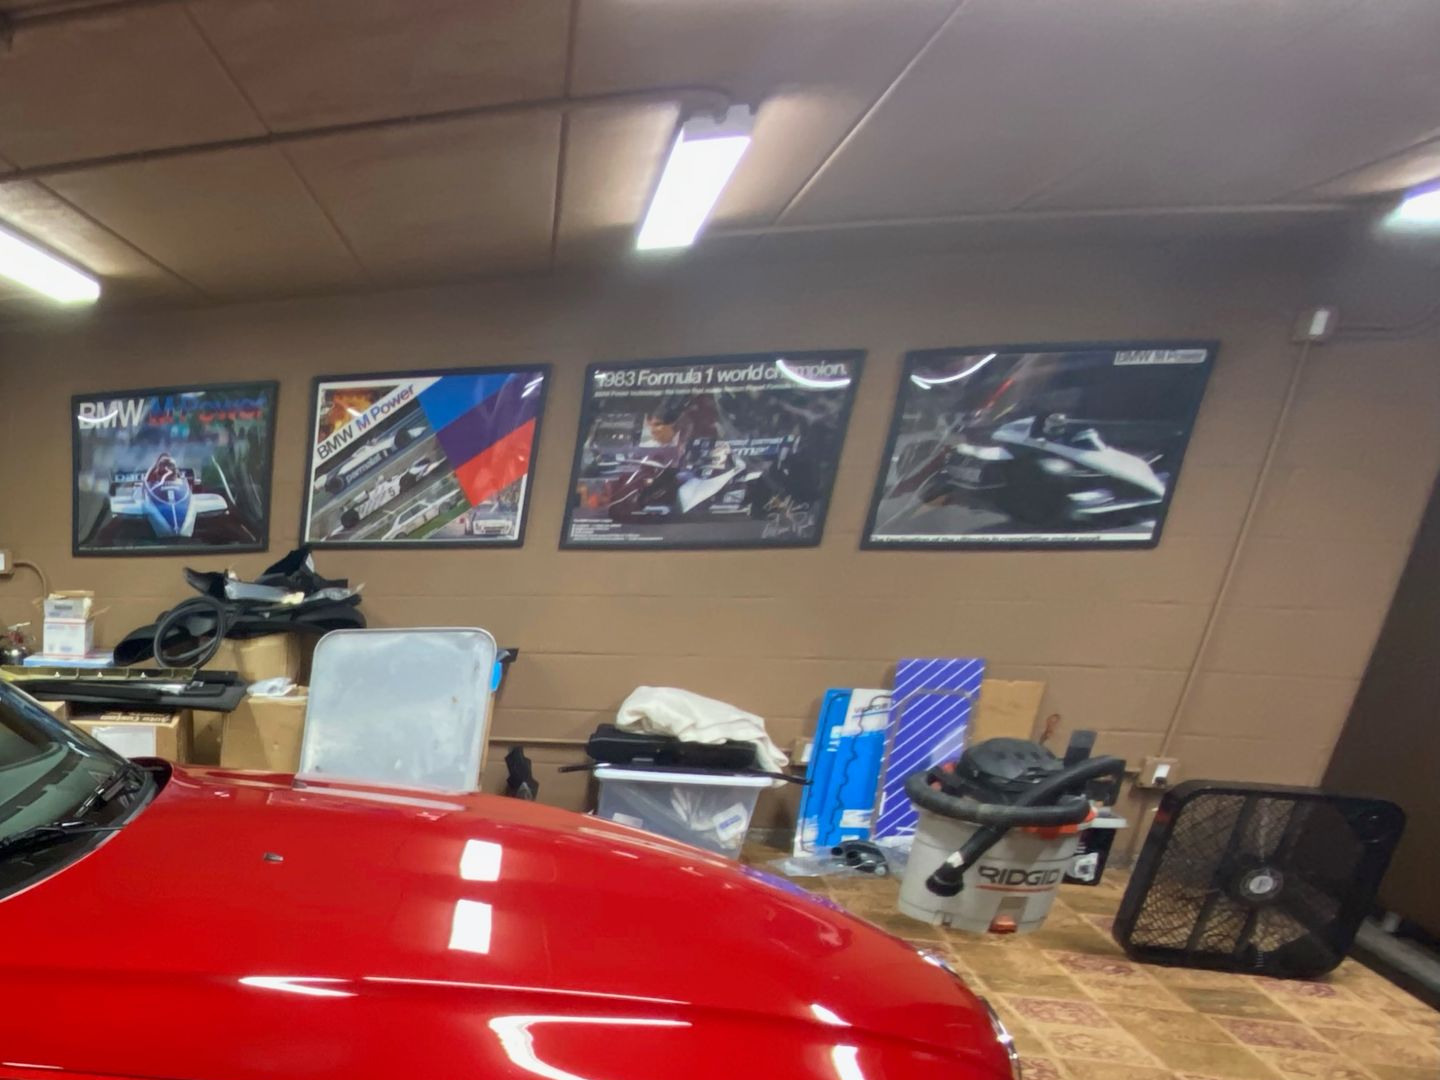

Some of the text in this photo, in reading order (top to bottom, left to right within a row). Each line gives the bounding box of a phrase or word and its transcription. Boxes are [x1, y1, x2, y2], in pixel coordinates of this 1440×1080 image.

[637, 367, 702, 386] Formula
[705, 367, 714, 383] 1
[717, 363, 764, 383] world
[79, 398, 145, 430] BMW
[317, 384, 415, 460] BMW M Power
[978, 865, 1061, 886] RIDGID
